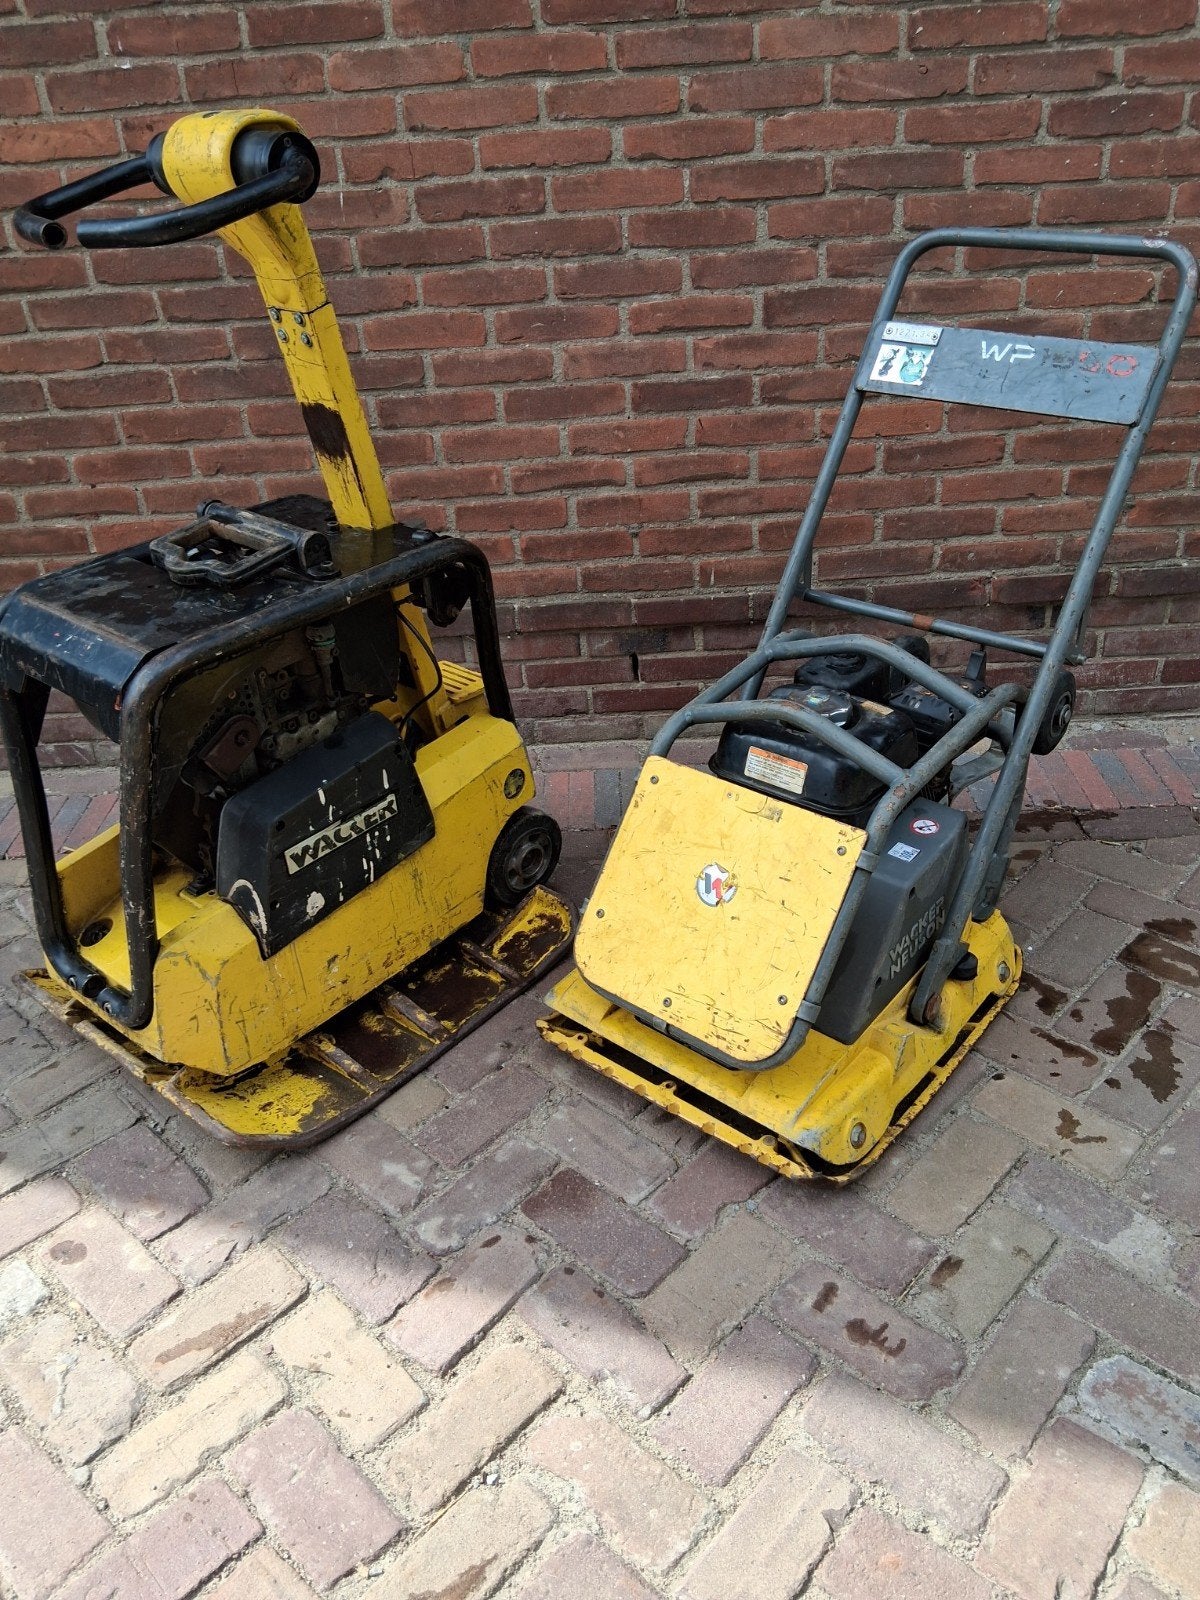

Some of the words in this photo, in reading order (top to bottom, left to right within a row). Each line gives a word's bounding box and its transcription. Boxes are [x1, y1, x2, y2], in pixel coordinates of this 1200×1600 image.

[288, 799, 398, 869] WACKER
[889, 895, 945, 962] WACKER
[890, 907, 946, 981] NEUSON
